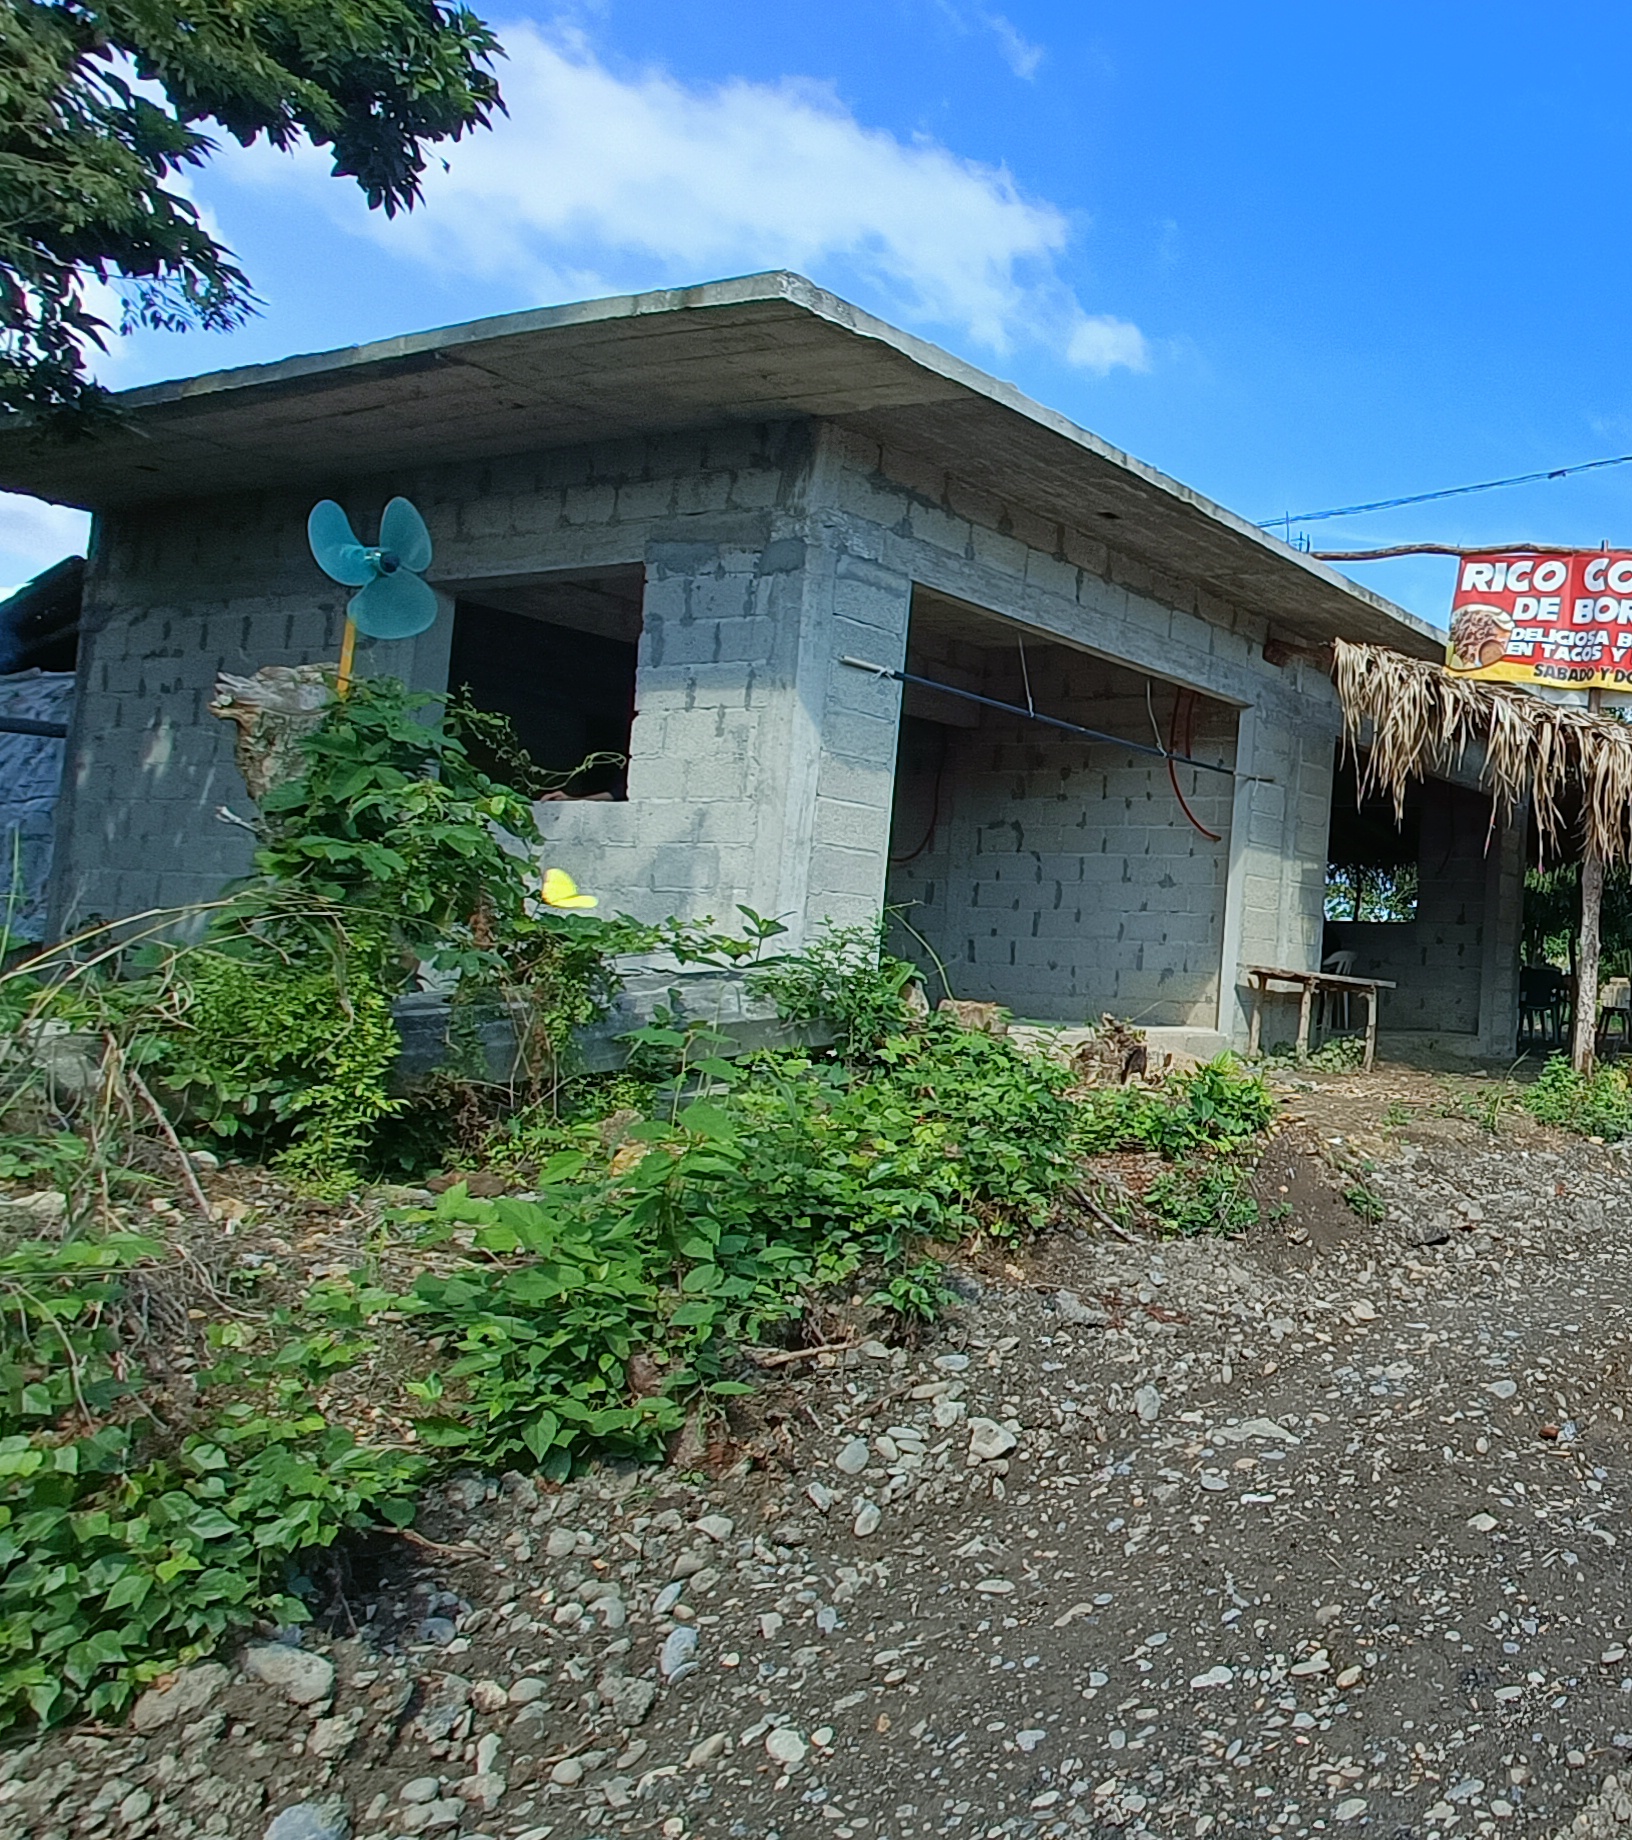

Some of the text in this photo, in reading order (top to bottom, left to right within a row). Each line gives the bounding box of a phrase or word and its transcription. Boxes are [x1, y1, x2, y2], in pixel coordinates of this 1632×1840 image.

[1461, 561, 1567, 592] RICO
[1512, 597, 1560, 622] DE
[1511, 628, 1609, 646] DELICIOSA
[1506, 642, 1533, 656] EN
[1541, 645, 1602, 661] TACOS
[1611, 648, 1626, 662] Y
[1533, 664, 1595, 681] SABADO
[1600, 667, 1611, 681] Y
